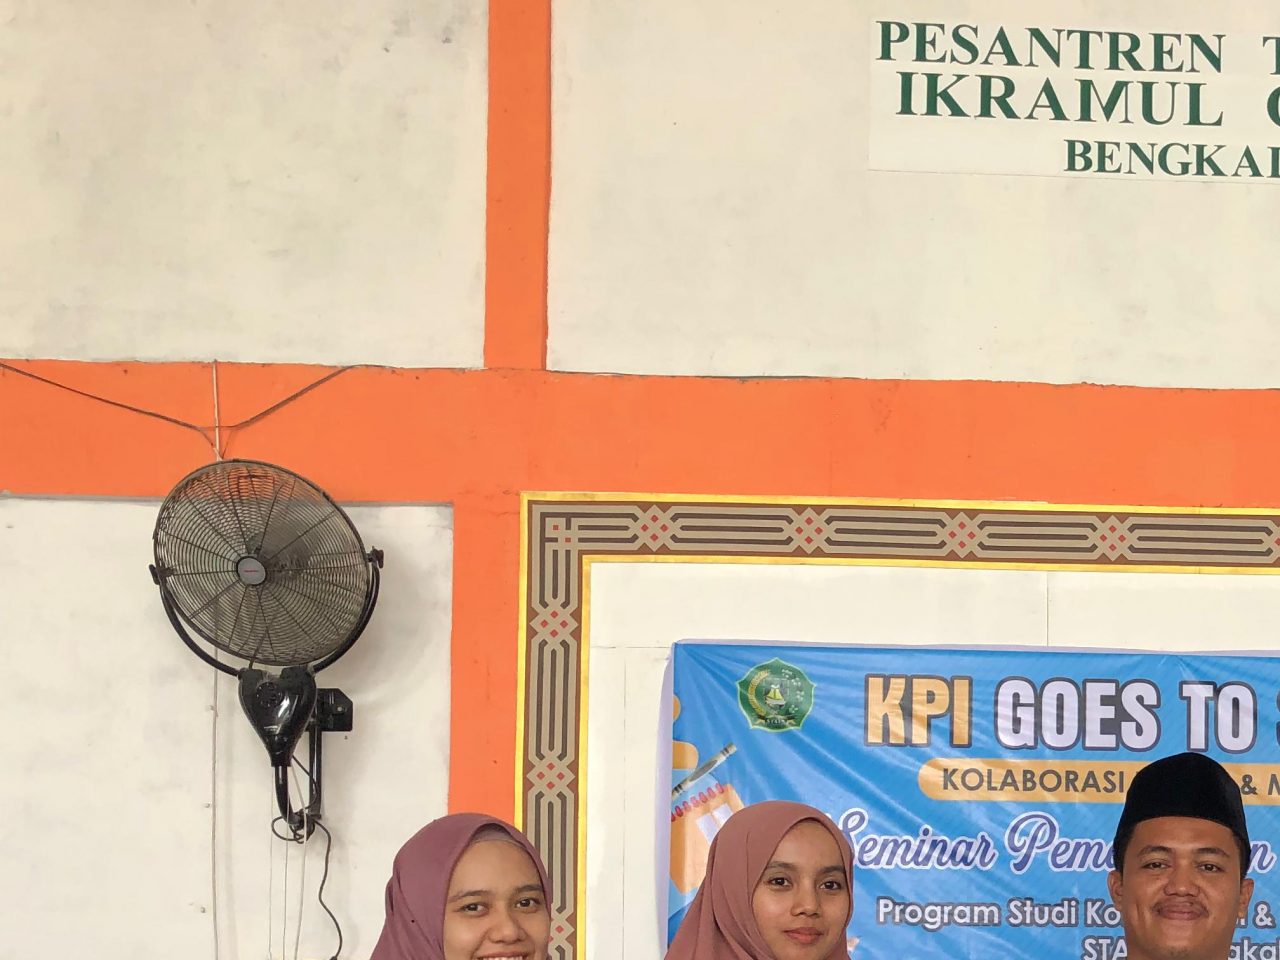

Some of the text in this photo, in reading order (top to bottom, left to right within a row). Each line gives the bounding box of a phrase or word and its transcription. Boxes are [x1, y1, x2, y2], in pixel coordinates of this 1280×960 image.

[875, 20, 1227, 75] PESANTREN
[895, 70, 1225, 128] IKRAMUL
[865, 675, 974, 747] KPI
[995, 677, 1161, 751] GOES
[1180, 681, 1258, 753] TO
[942, 767, 1125, 793] KOLABORASI
[1240, 774, 1258, 796] &
[839, 809, 998, 872] Seminar
[877, 897, 1000, 932] Program
[1007, 898, 1078, 927] Studi
[1254, 902, 1275, 928] &
